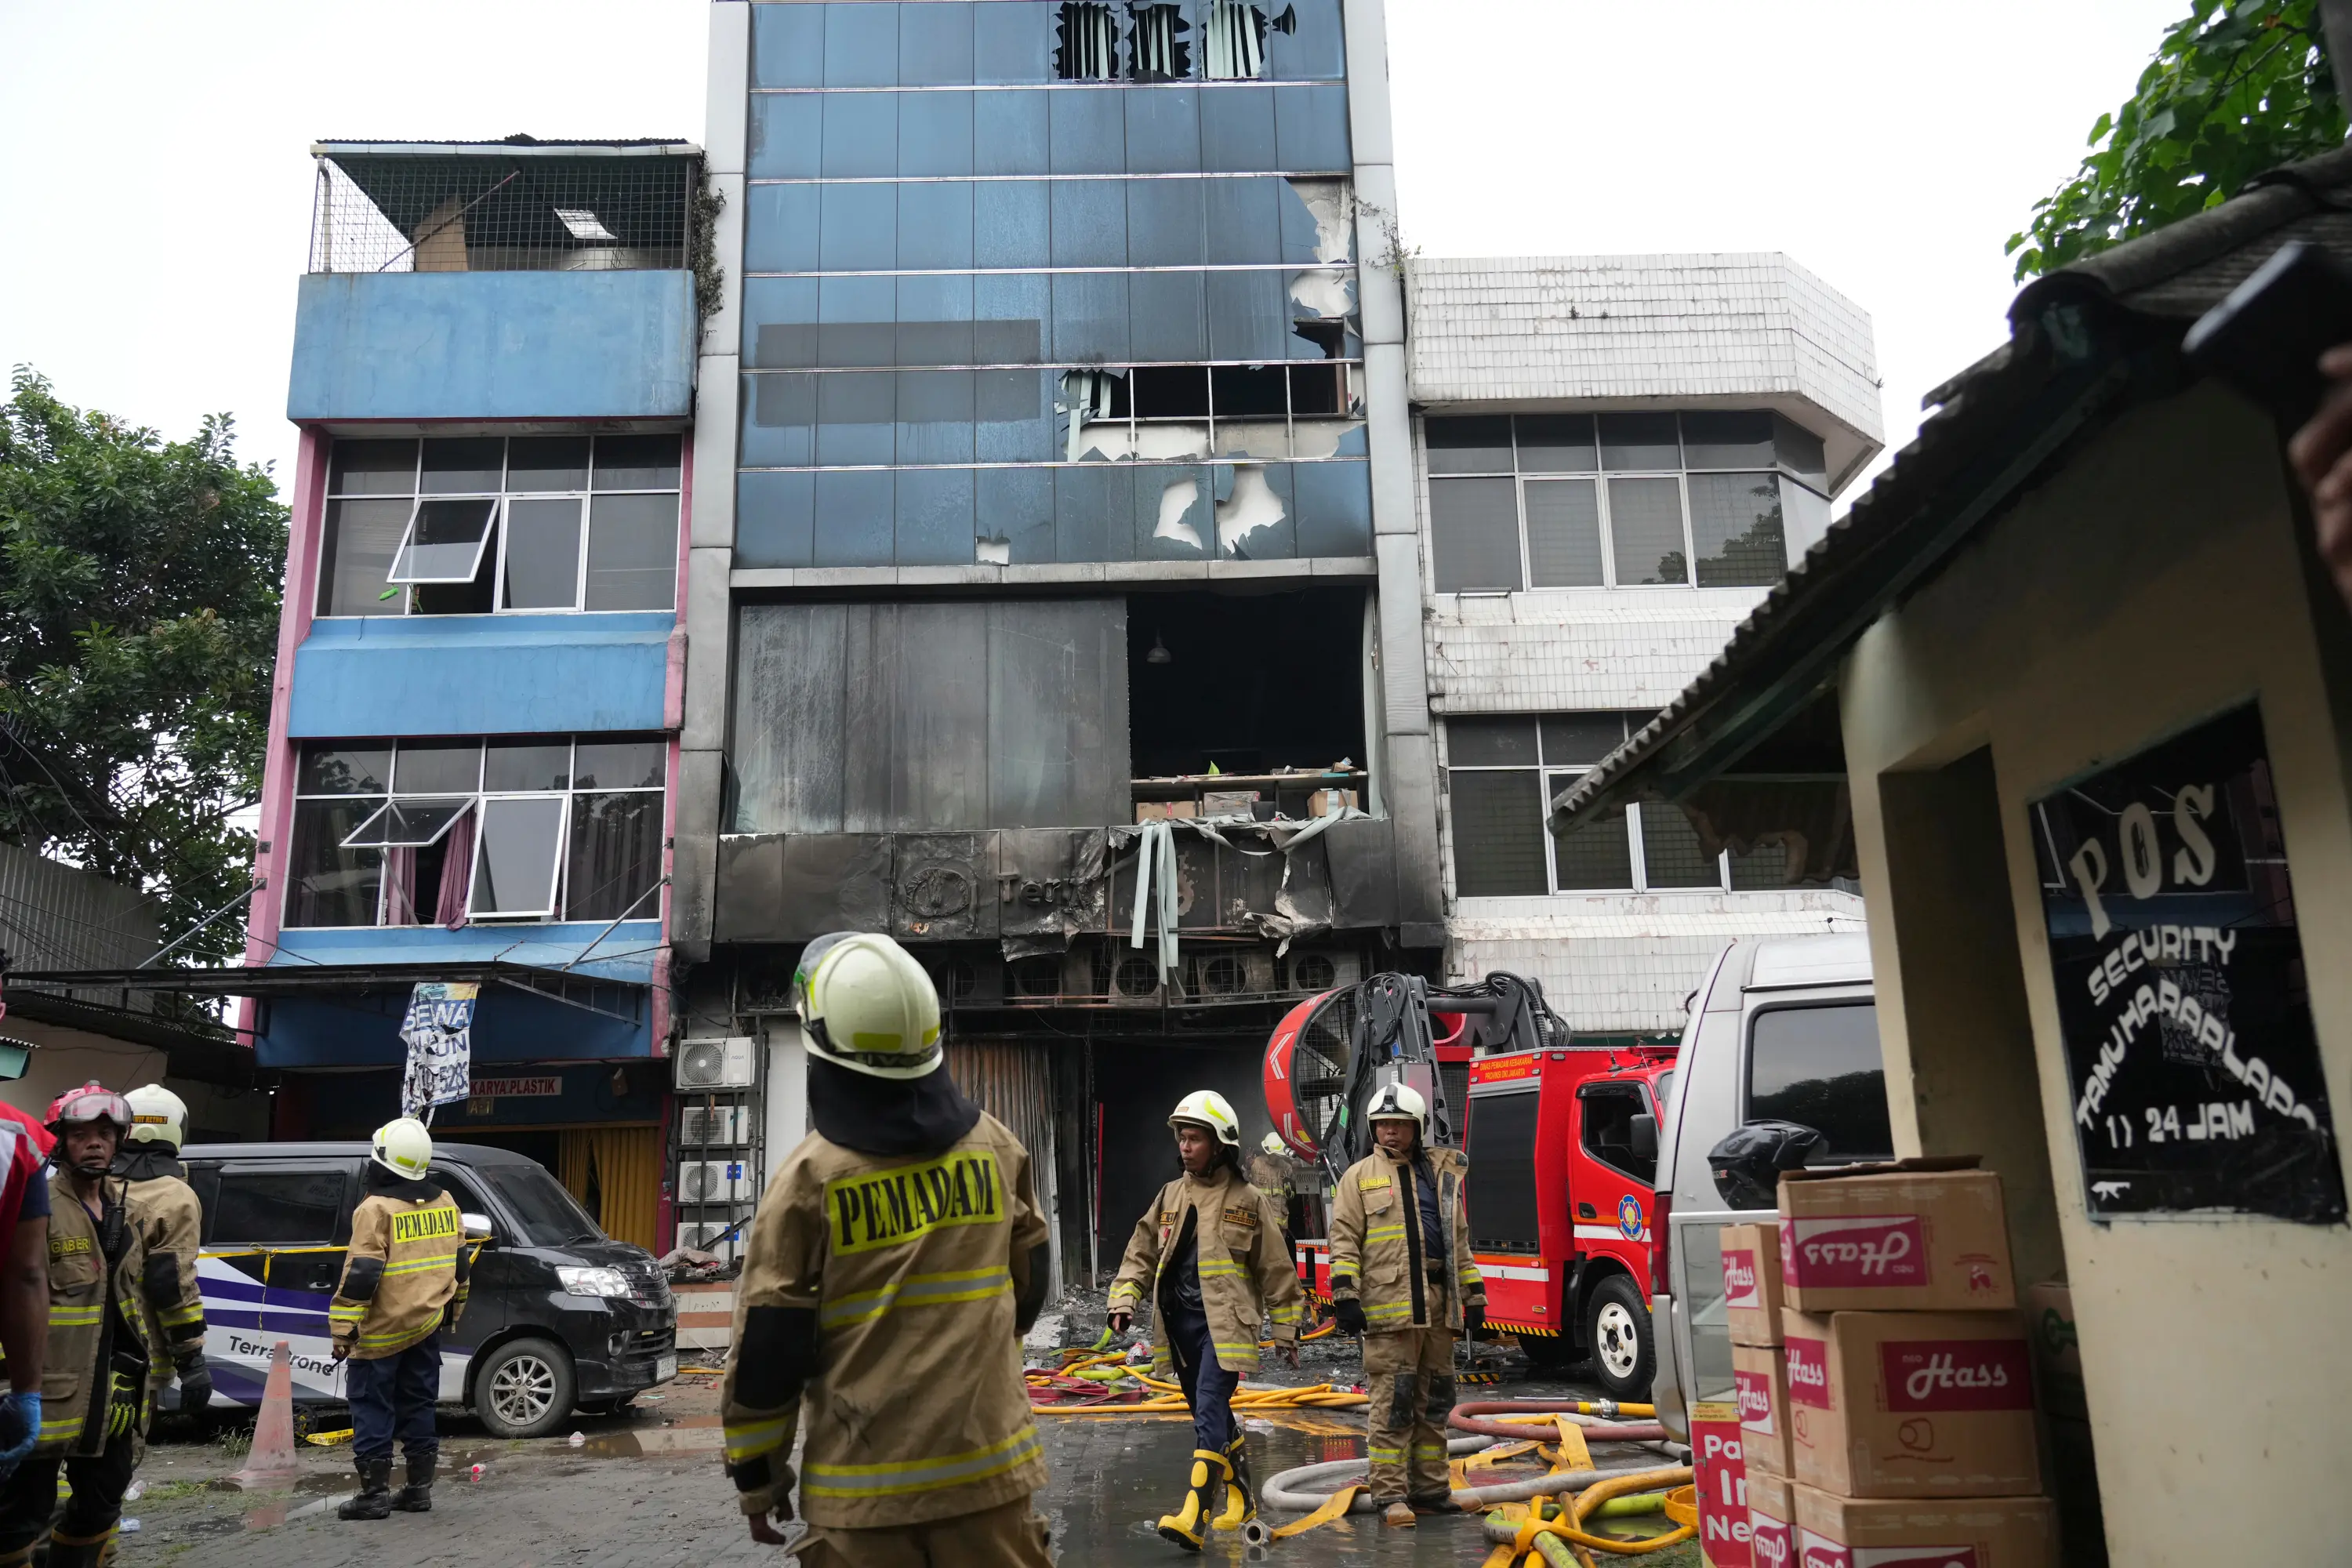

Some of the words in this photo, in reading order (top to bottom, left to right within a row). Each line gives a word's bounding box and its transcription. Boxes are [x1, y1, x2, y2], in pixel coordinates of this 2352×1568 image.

[2069, 784, 2215, 942] POS
[2088, 924, 2236, 1007] SECURITY
[404, 1002, 470, 1029] SEWA
[1485, 1071, 1501, 1080] PROVINSI
[1508, 1069, 1526, 1077] JAKARTA
[1490, 1059, 1509, 1069] PEMADAM
[1509, 1056, 1533, 1067] KEBAKARAN
[2077, 1025, 2125, 1131] TAMU
[2118, 978, 2224, 1051] HARAP
[509, 1078, 556, 1094] PLASTIK
[2145, 1105, 2180, 1143] 24
[2186, 1099, 2255, 1141] JAM
[834, 1159, 994, 1247] PEMADAM
[395, 1210, 455, 1240] PEMADAM
[1803, 1230, 1911, 1276] Hass
[1787, 1348, 1824, 1388] Hass
[1906, 1352, 2009, 1400] Hass
[1706, 1514, 1751, 1542] Ne
